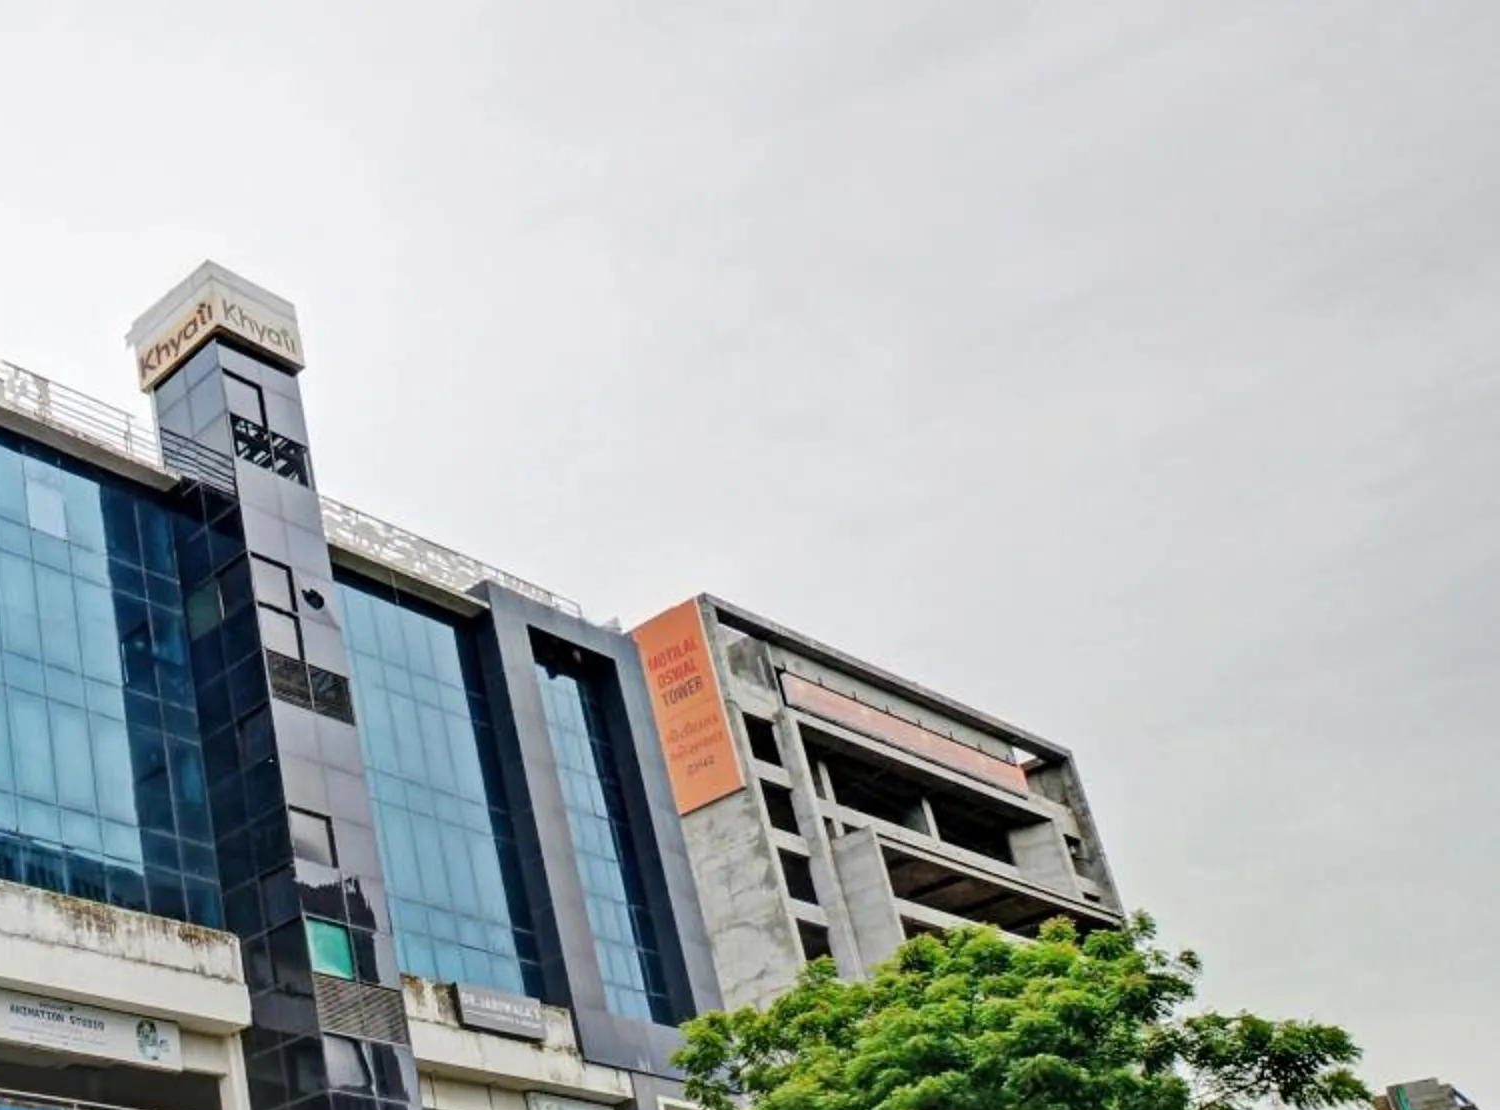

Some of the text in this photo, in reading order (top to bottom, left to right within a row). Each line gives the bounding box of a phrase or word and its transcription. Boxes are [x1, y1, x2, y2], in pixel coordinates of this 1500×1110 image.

[140, 302, 214, 379] Khyati
[221, 299, 297, 355] Khyati
[662, 676, 703, 707] TOWER
